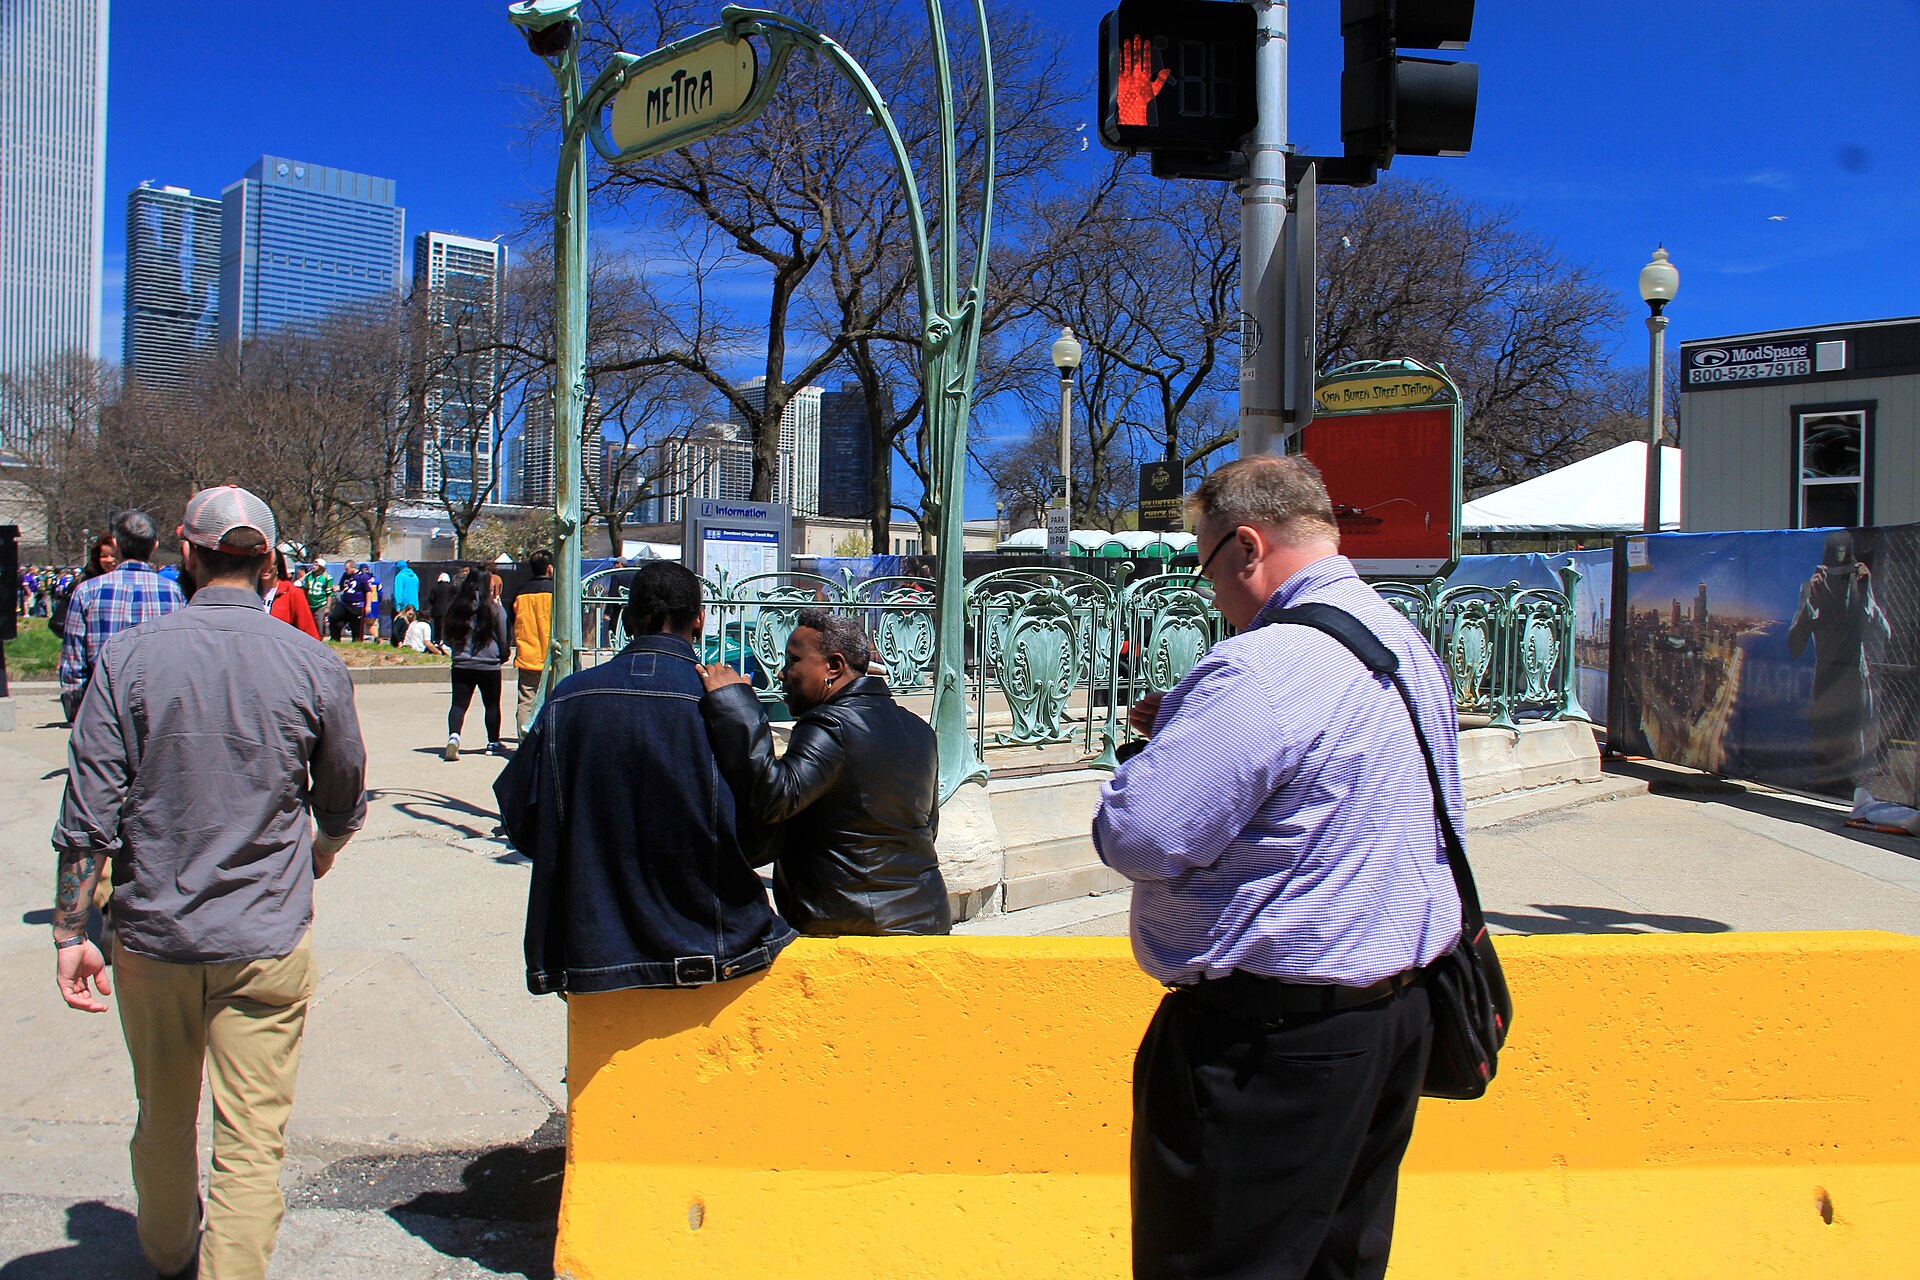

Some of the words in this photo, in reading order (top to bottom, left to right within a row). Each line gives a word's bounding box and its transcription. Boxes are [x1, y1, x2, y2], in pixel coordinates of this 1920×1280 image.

[646, 69, 713, 128] METRA
[1731, 345, 1807, 362] ModSpace
[1692, 361, 1808, 383] 800-523-7918
[1343, 388, 1370, 402] BUREN
[1373, 384, 1400, 399] STREET
[1401, 382, 1434, 398] STATION
[716, 505, 767, 518] Information
[308, 580, 322, 596] 15
